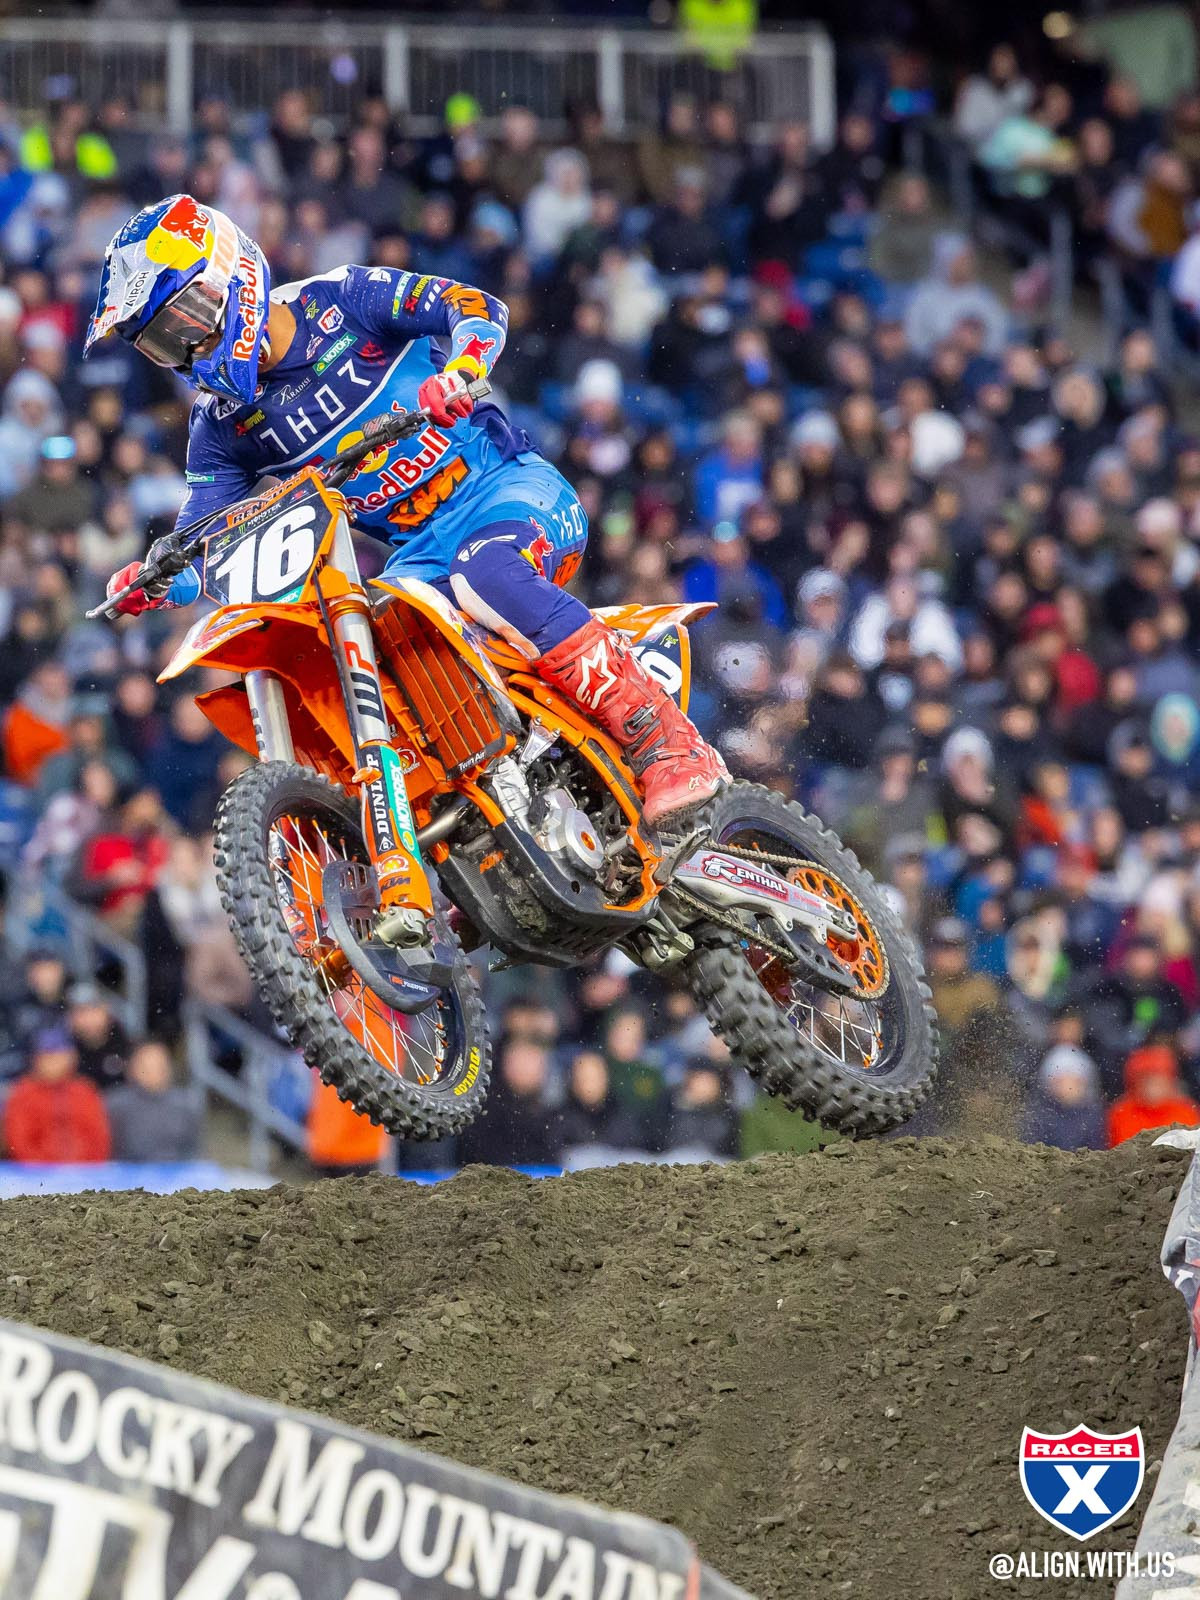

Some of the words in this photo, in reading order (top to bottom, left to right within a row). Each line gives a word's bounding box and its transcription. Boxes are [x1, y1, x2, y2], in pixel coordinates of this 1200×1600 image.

[215, 505, 316, 605] 16
[365, 753, 390, 834] DUNLP
[389, 760, 413, 832] MOTOREX
[704, 857, 787, 894] RENTHAL
